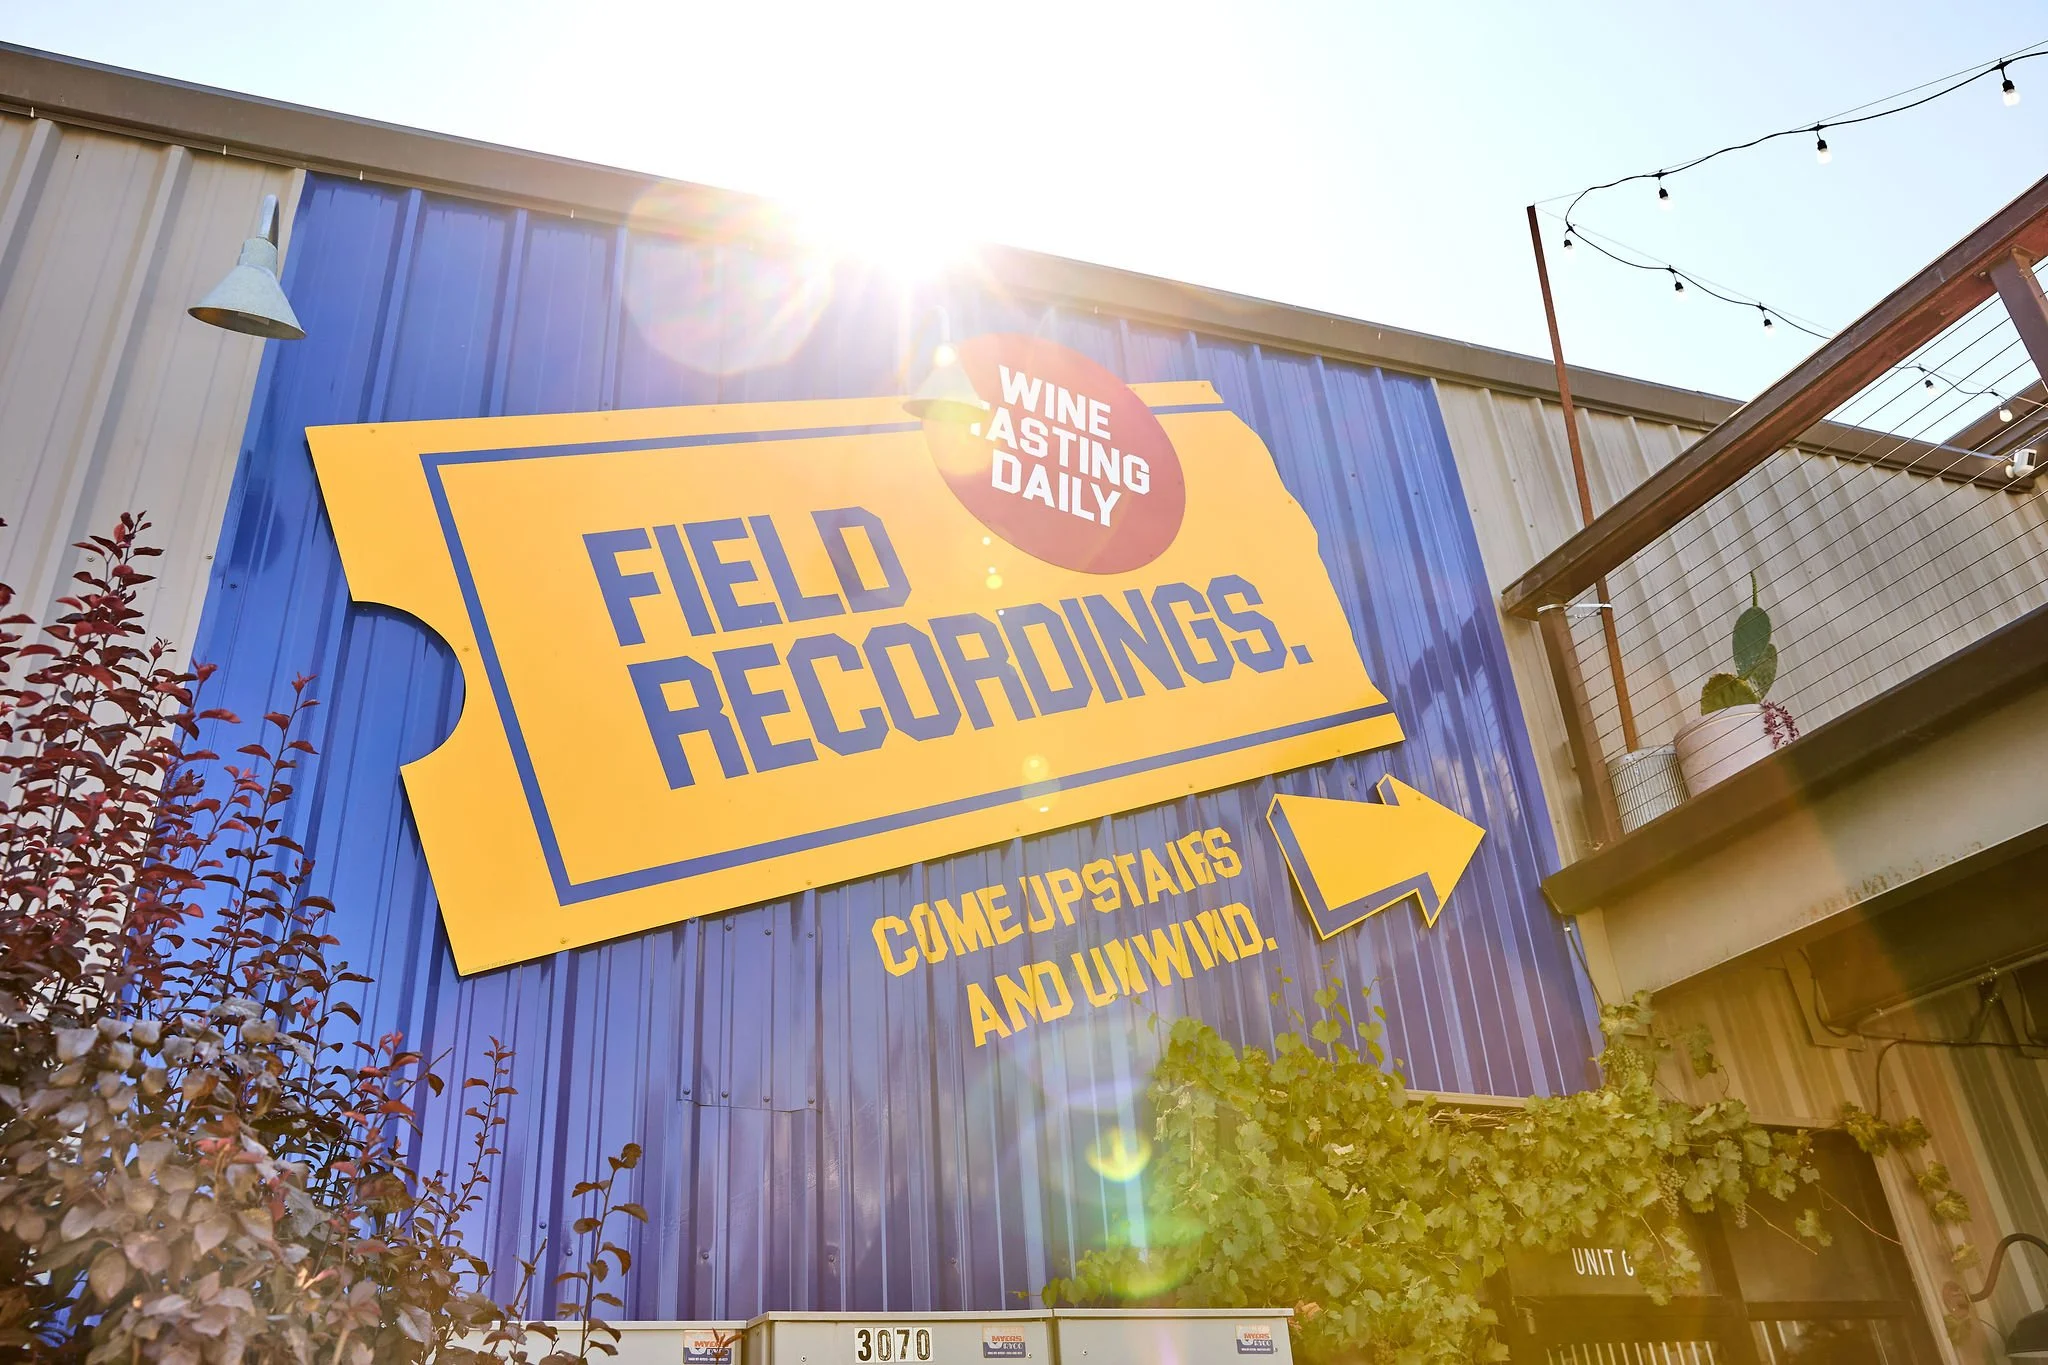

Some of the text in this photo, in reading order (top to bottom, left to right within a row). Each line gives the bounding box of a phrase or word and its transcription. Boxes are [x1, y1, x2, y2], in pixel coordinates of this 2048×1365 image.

[998, 364, 1111, 441] WINE
[968, 404, 1151, 495] ASTING
[991, 448, 1122, 527] DAILY
[582, 506, 912, 647] FIELD
[626, 574, 1314, 790] RECORDINGS.
[871, 826, 1243, 977] COME UPSTAIRS
[966, 902, 1279, 1048] AND UNWIND.
[1571, 1247, 1616, 1276] UNIT
[857, 1329, 931, 1361] 3070
